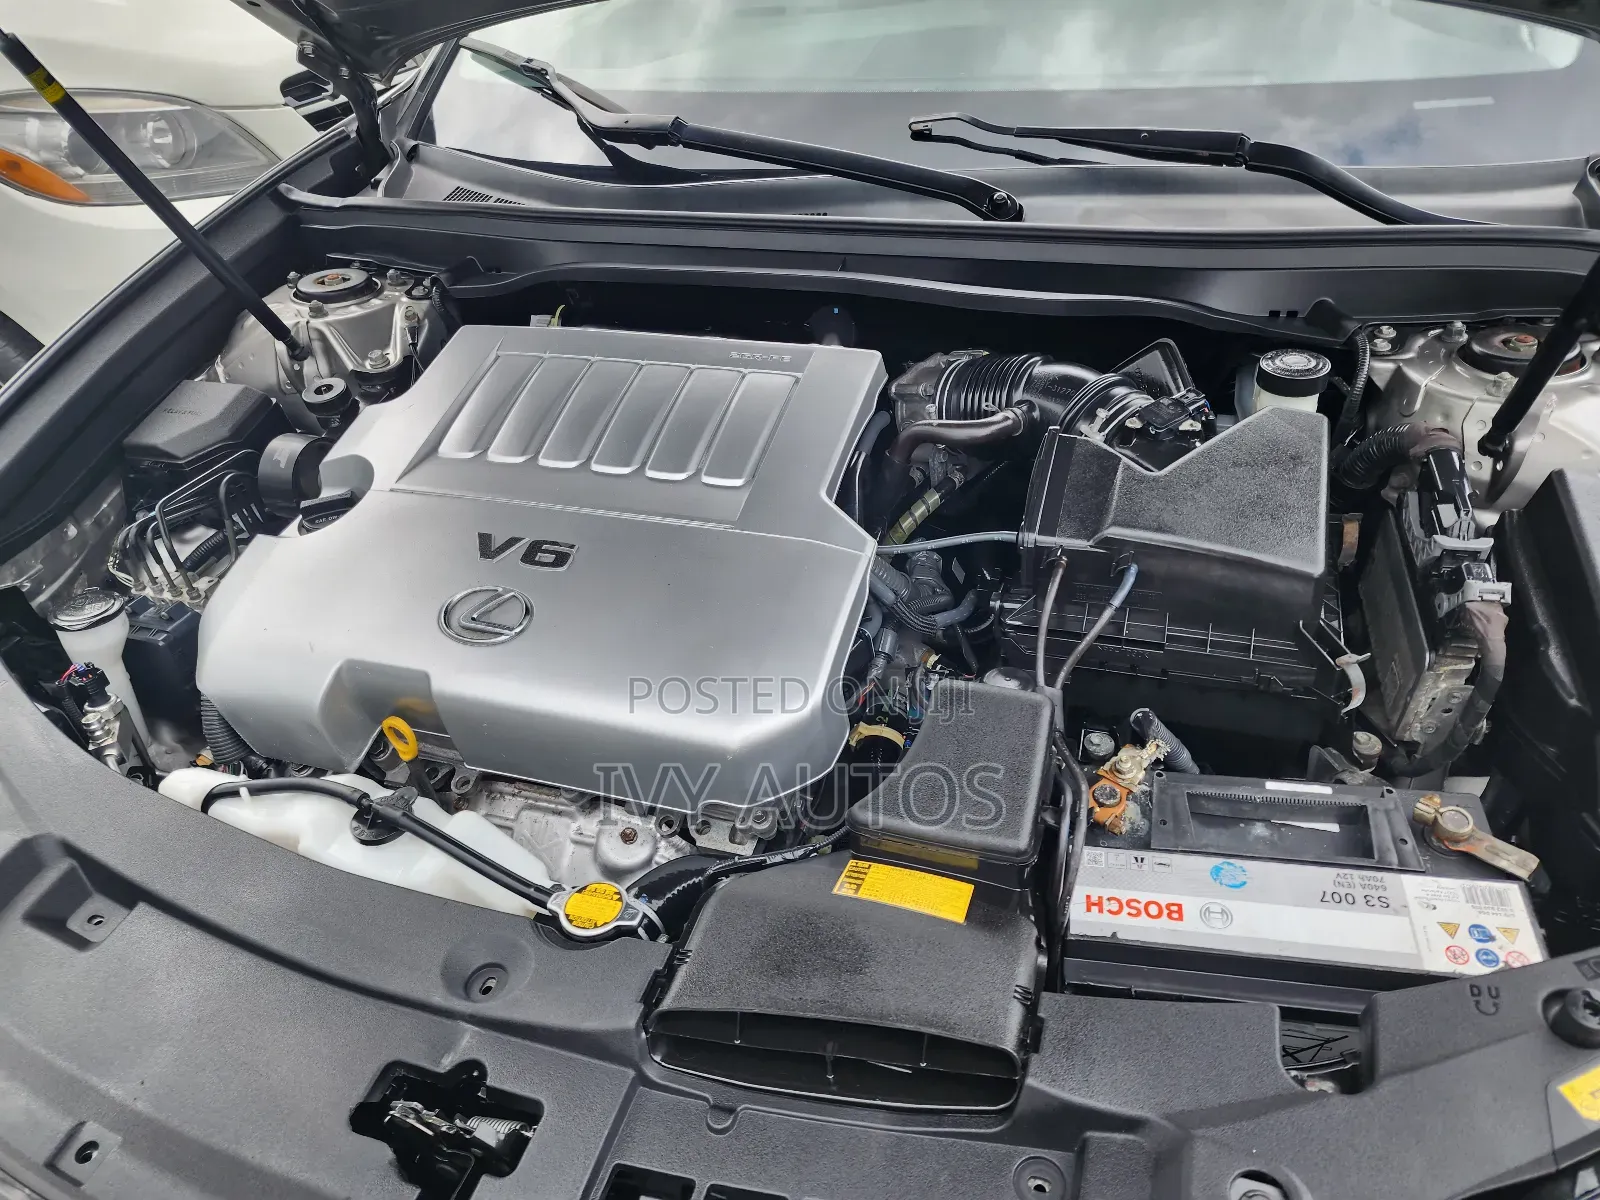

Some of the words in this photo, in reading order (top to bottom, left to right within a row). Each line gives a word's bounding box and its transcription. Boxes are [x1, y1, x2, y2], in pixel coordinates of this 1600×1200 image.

[476, 531, 580, 572] V6
[1335, 872, 1354, 880] 12V
[1358, 874, 1385, 883] 70Ah
[1360, 882, 1387, 892] 640A
[1320, 890, 1356, 905] 007
[1363, 894, 1390, 909] S3
[1085, 895, 1184, 922] BOSCH
